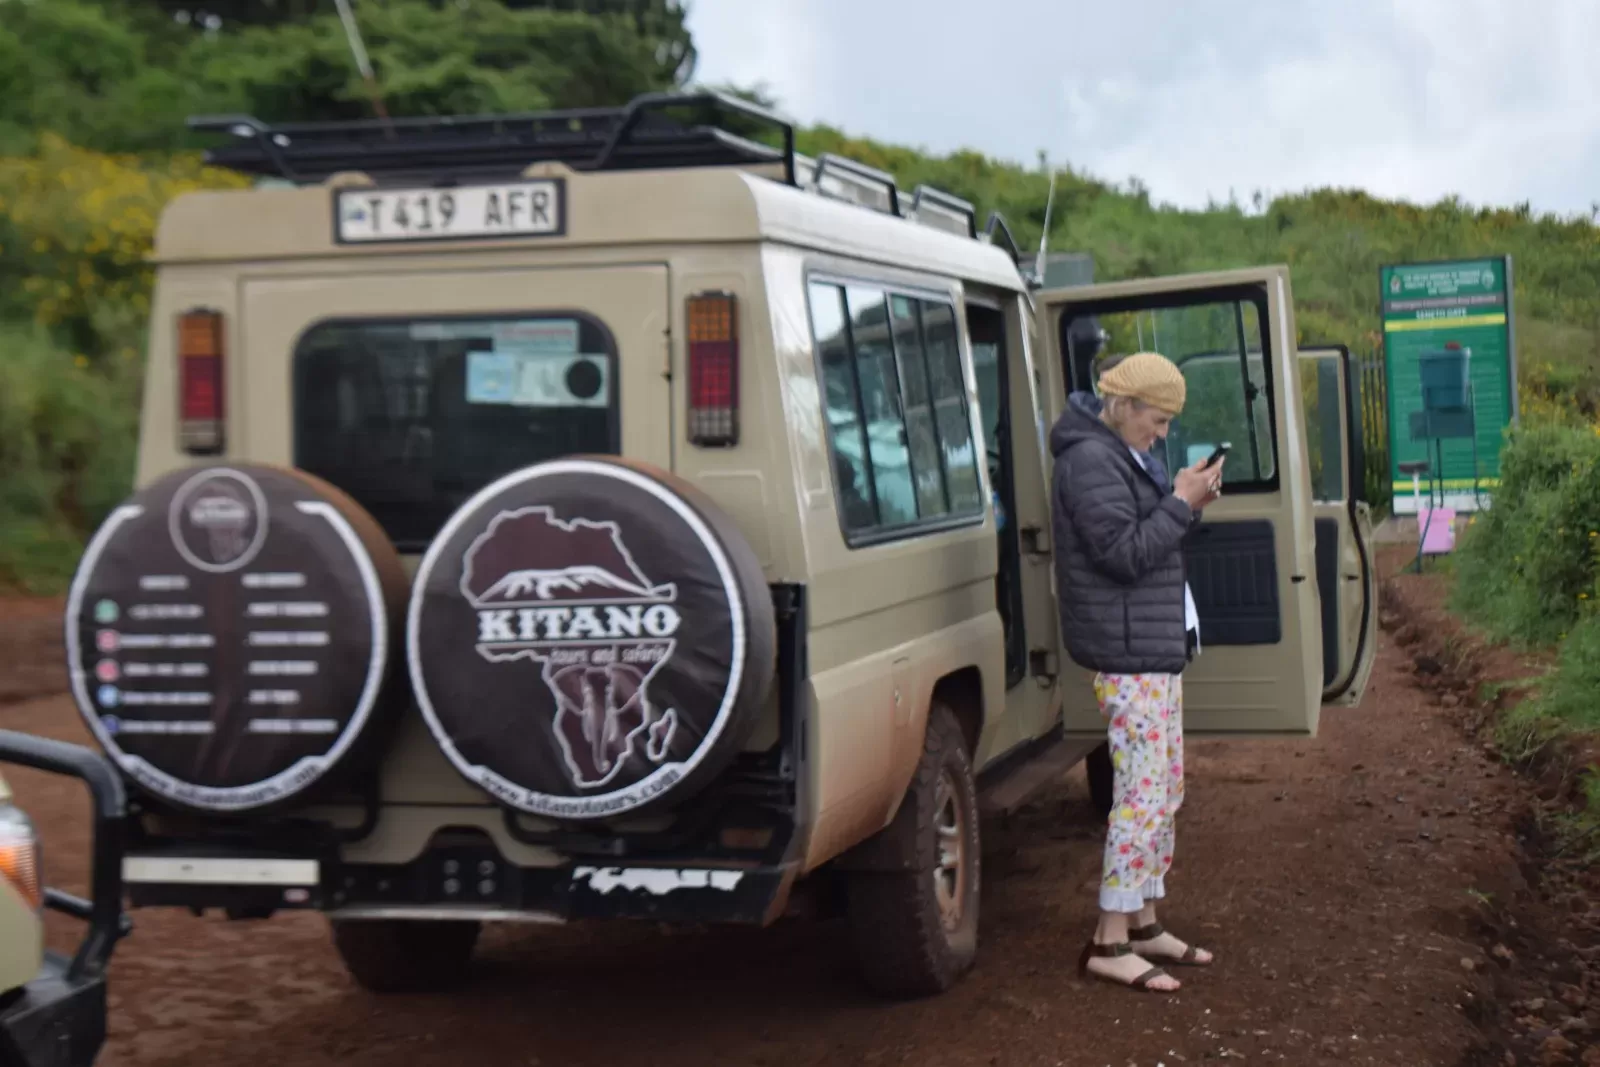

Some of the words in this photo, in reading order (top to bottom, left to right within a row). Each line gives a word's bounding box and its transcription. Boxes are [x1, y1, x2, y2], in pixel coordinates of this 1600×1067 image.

[369, 199, 382, 231] T
[393, 194, 456, 229] 419
[484, 191, 549, 226] AFR
[477, 604, 681, 642] KITANO
